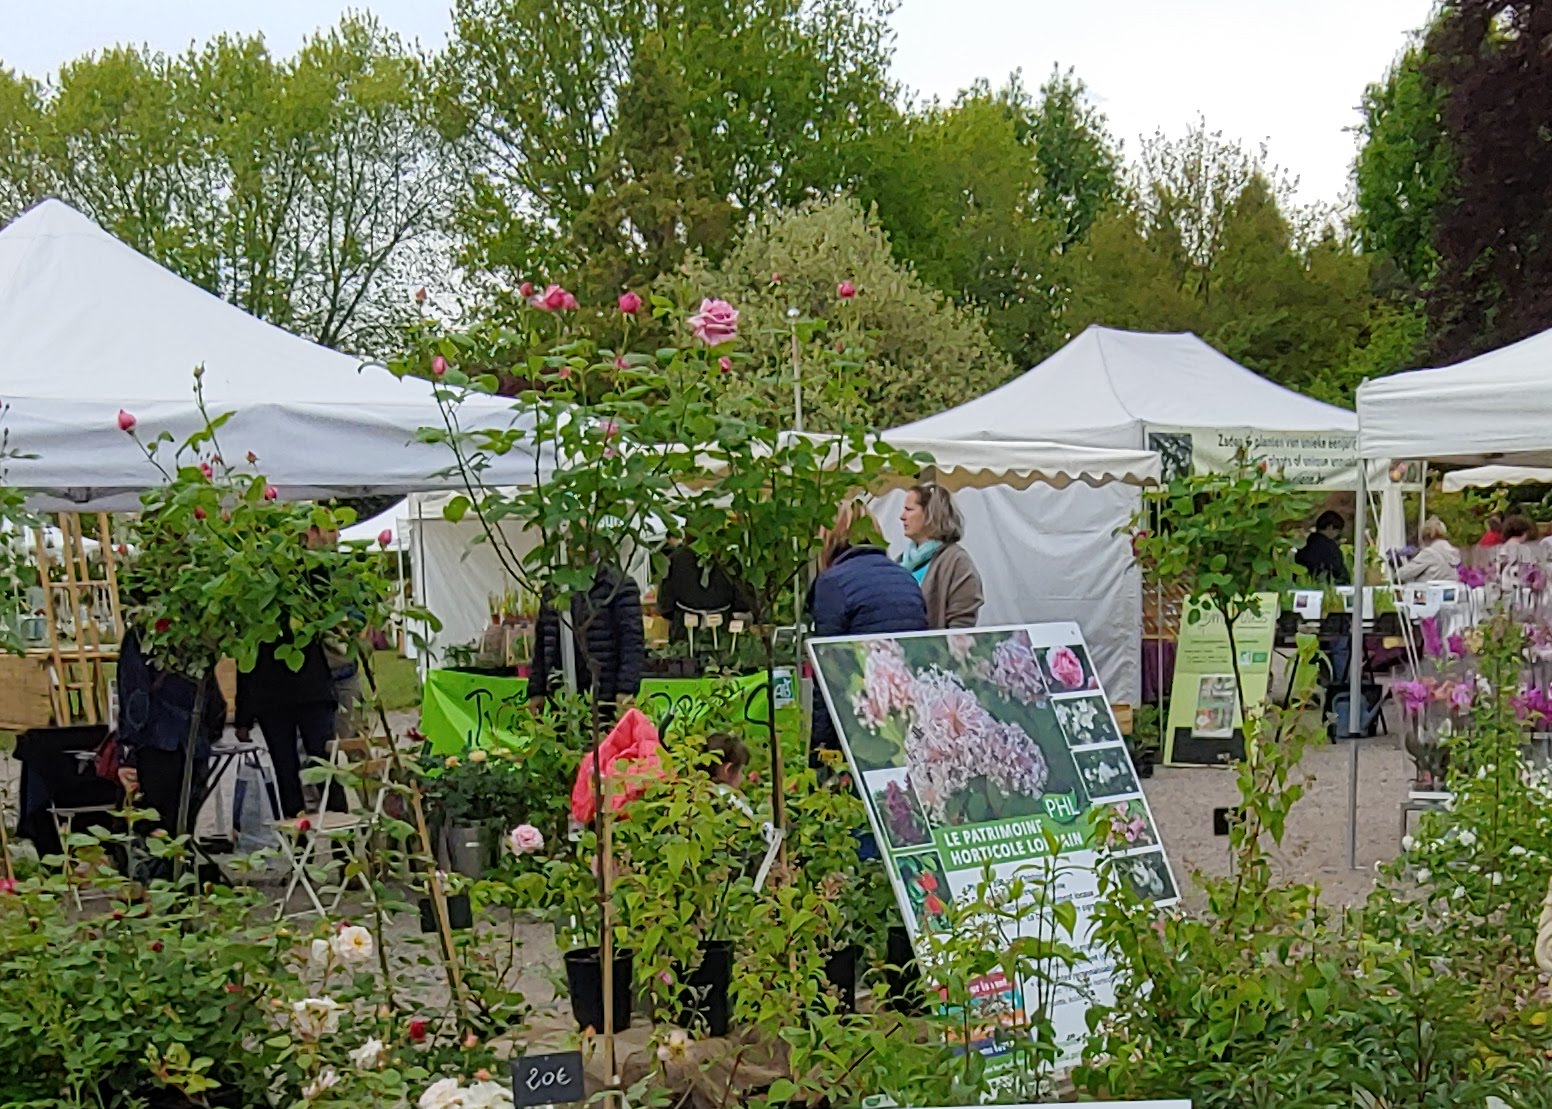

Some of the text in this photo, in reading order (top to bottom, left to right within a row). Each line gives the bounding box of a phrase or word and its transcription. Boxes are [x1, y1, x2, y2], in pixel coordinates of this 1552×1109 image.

[1045, 796, 1081, 818] PHL
[944, 831, 960, 847] LE
[950, 831, 1084, 866] HORTICOLE LOAIN
[525, 1066, 572, 1092] 20€
